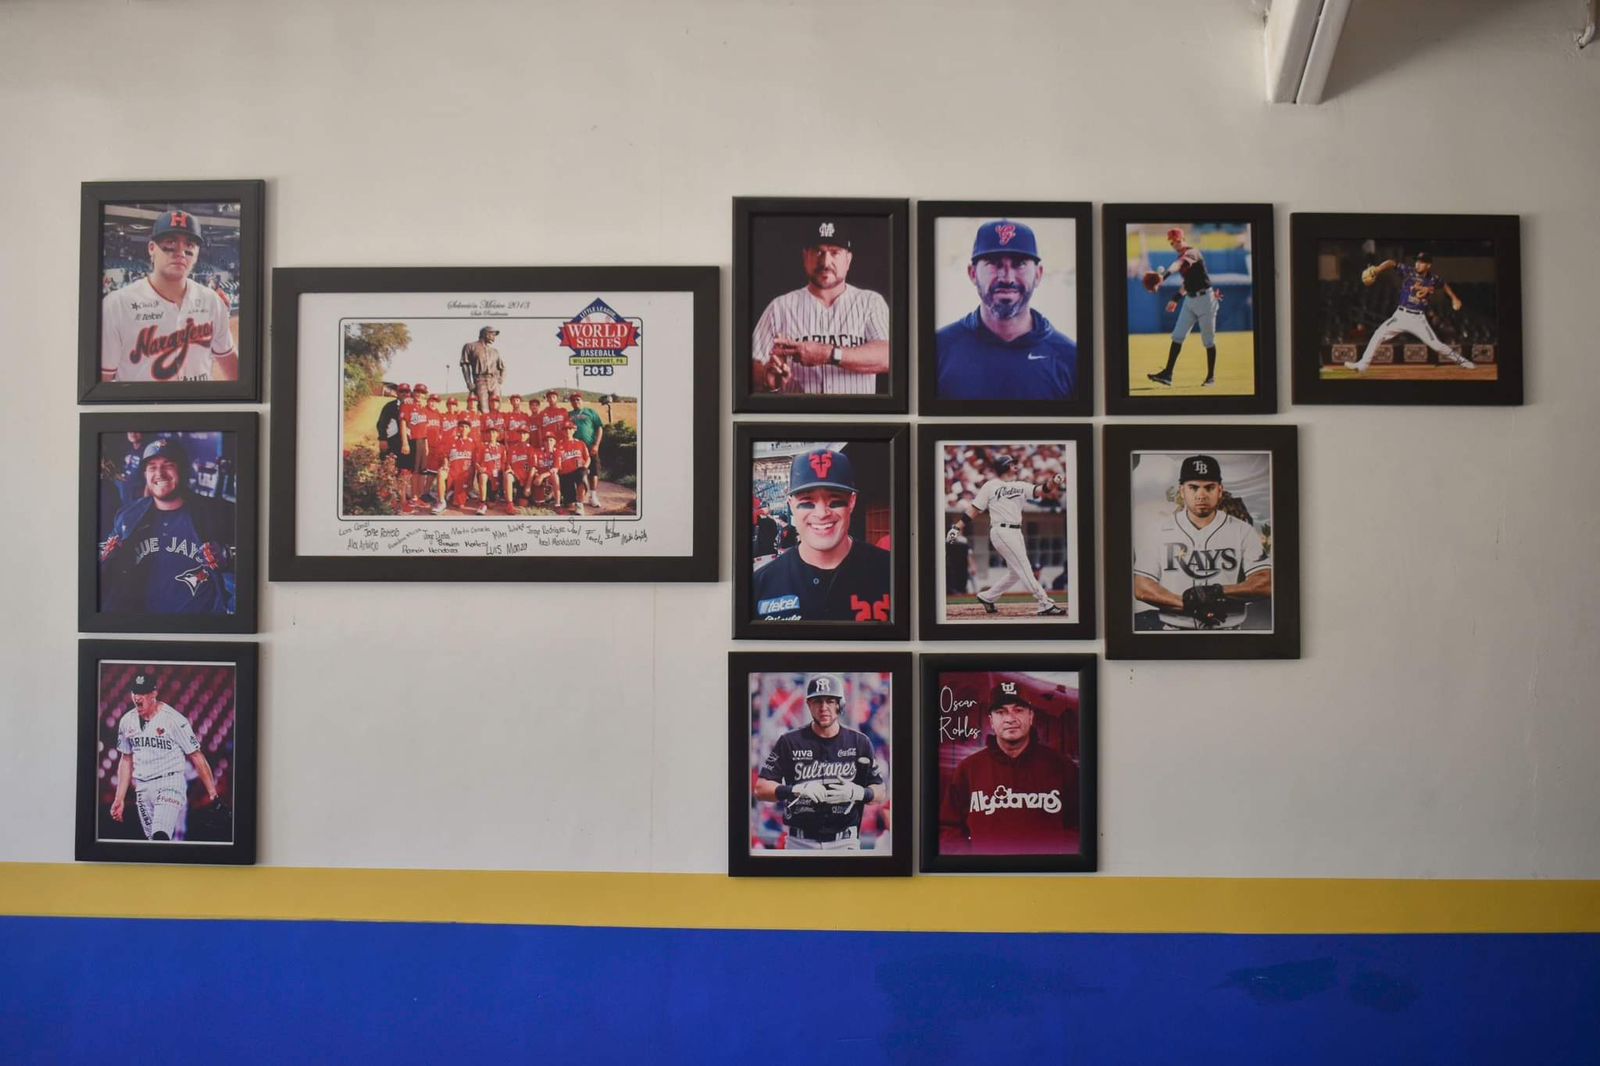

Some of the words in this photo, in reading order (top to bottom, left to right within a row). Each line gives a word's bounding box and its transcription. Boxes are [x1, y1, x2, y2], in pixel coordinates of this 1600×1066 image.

[170, 211, 188, 228] H
[580, 306, 596, 319] LITTLE
[568, 324, 628, 338] WORLD
[576, 337, 621, 348] SERIES
[580, 349, 616, 357] BASEBALL
[584, 366, 613, 376] 2013
[1192, 460, 1208, 475] TB
[1163, 542, 1237, 579] RAYS
[940, 686, 977, 713] Oscar
[939, 716, 981, 743] Robles
[792, 749, 813, 757] viva
[794, 760, 857, 782] Sultanes
